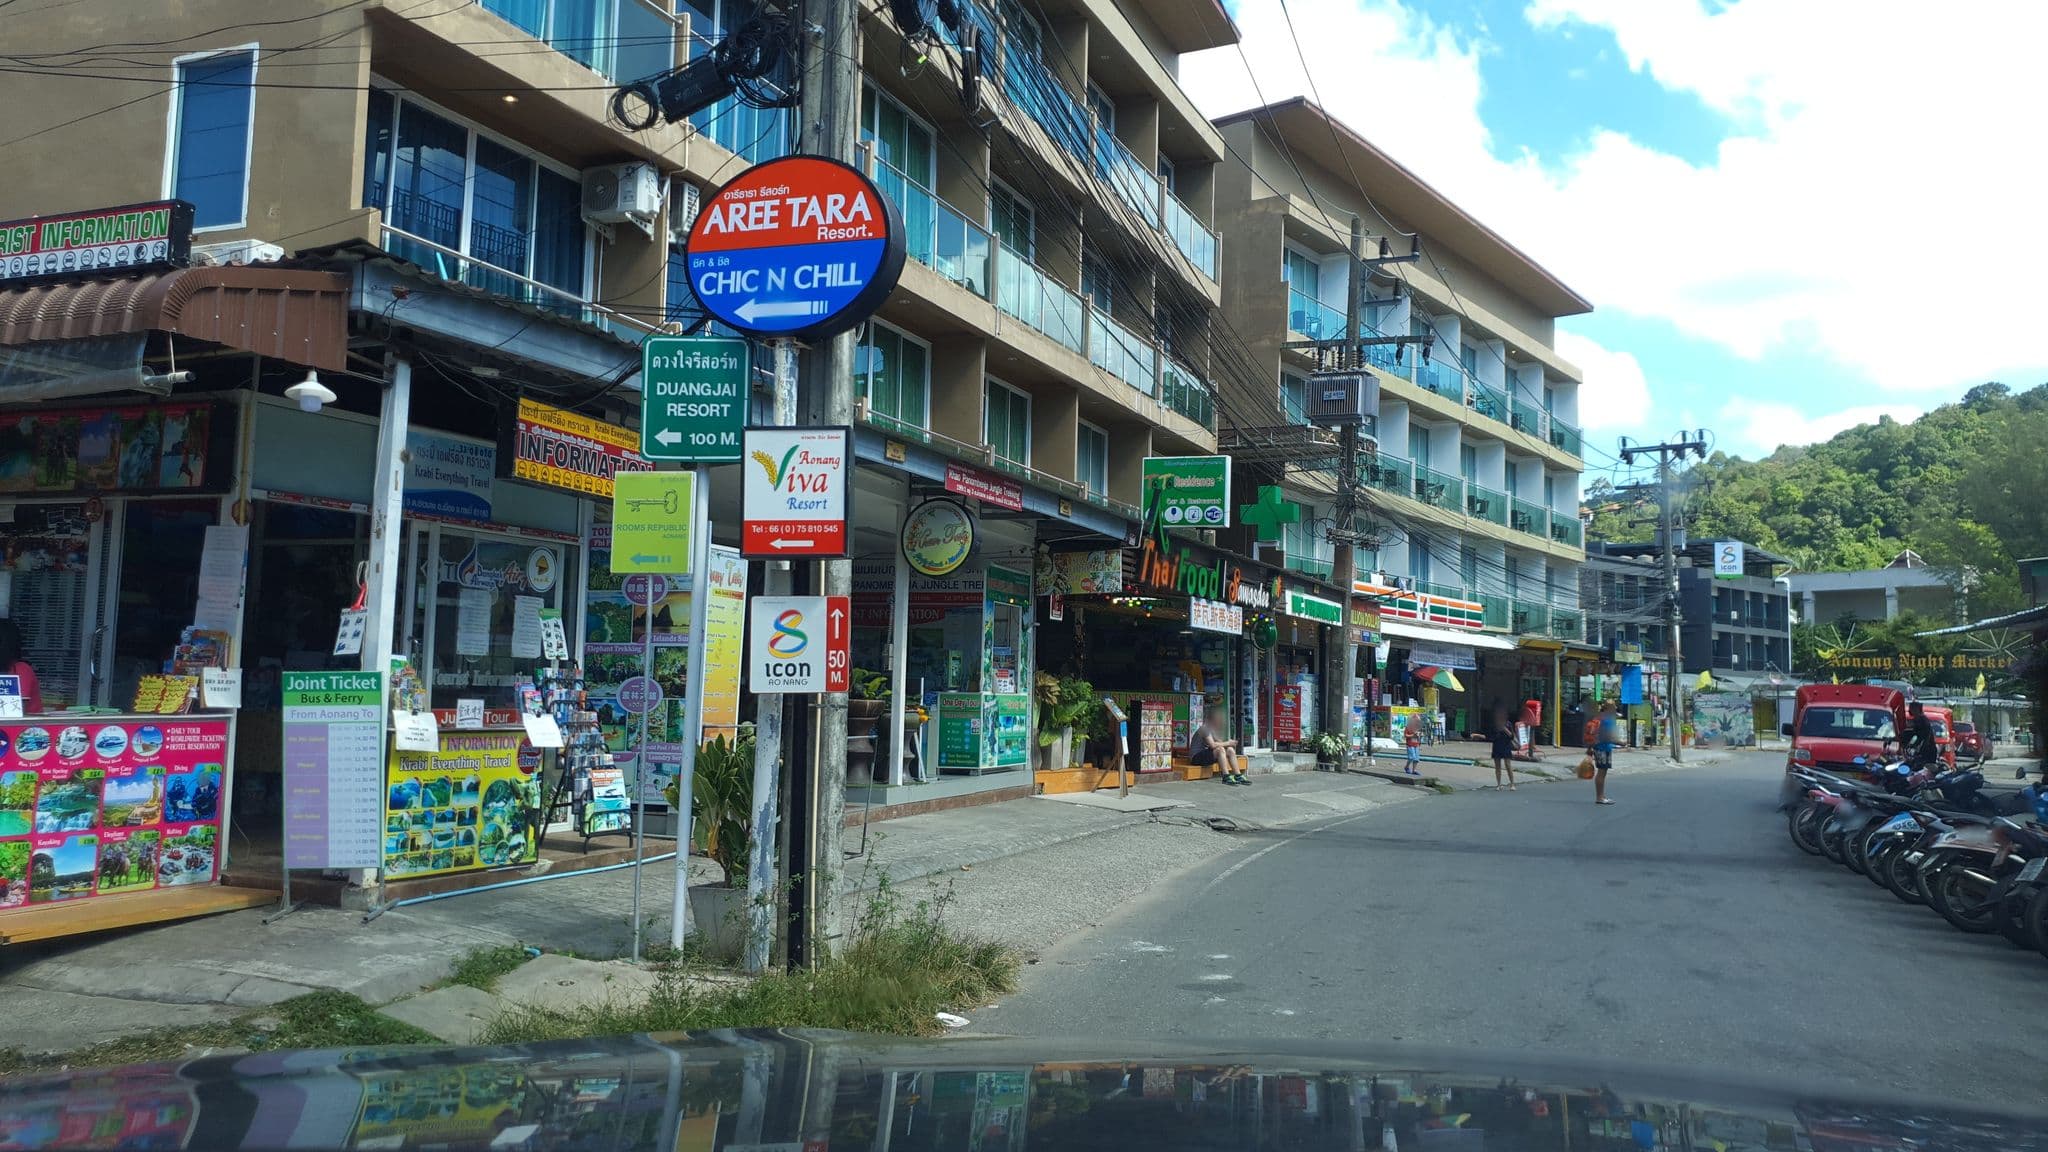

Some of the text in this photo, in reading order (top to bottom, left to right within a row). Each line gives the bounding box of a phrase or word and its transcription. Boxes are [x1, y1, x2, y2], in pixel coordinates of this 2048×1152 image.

[703, 191, 872, 235] AREE TARA
[41, 209, 171, 251] INFORMATION
[699, 262, 862, 295] CHIC N CHILL
[652, 350, 738, 370] ดวงใจรีสอร์ท
[656, 382, 737, 397] DUANGJAI
[666, 403, 731, 418] RESORT
[594, 423, 610, 435] Krabi
[689, 432, 740, 446] 100 M.
[519, 431, 654, 480] INFORMAT
[799, 450, 841, 470] Aonang
[787, 497, 828, 510] Resort
[616, 523, 687, 532] ROOMS REPUBLIC
[1140, 539, 1220, 600] Thai Food
[920, 581, 959, 590] JUNGLE
[587, 645, 614, 653] Elephant
[828, 650, 846, 669] 50
[1830, 654, 2013, 670] Aonang Night Market
[287, 675, 377, 690] Joint Ticket
[784, 678, 808, 686] NANG
[830, 671, 844, 684] M.
[301, 693, 364, 705] Bus & Ferry
[291, 708, 374, 720] From Aonang To
[484, 711, 510, 723] Tour
[447, 735, 517, 751] INFORMATION
[399, 756, 428, 771] Krabi
[430, 755, 481, 772] Everything
[483, 753, 512, 768] Travel
